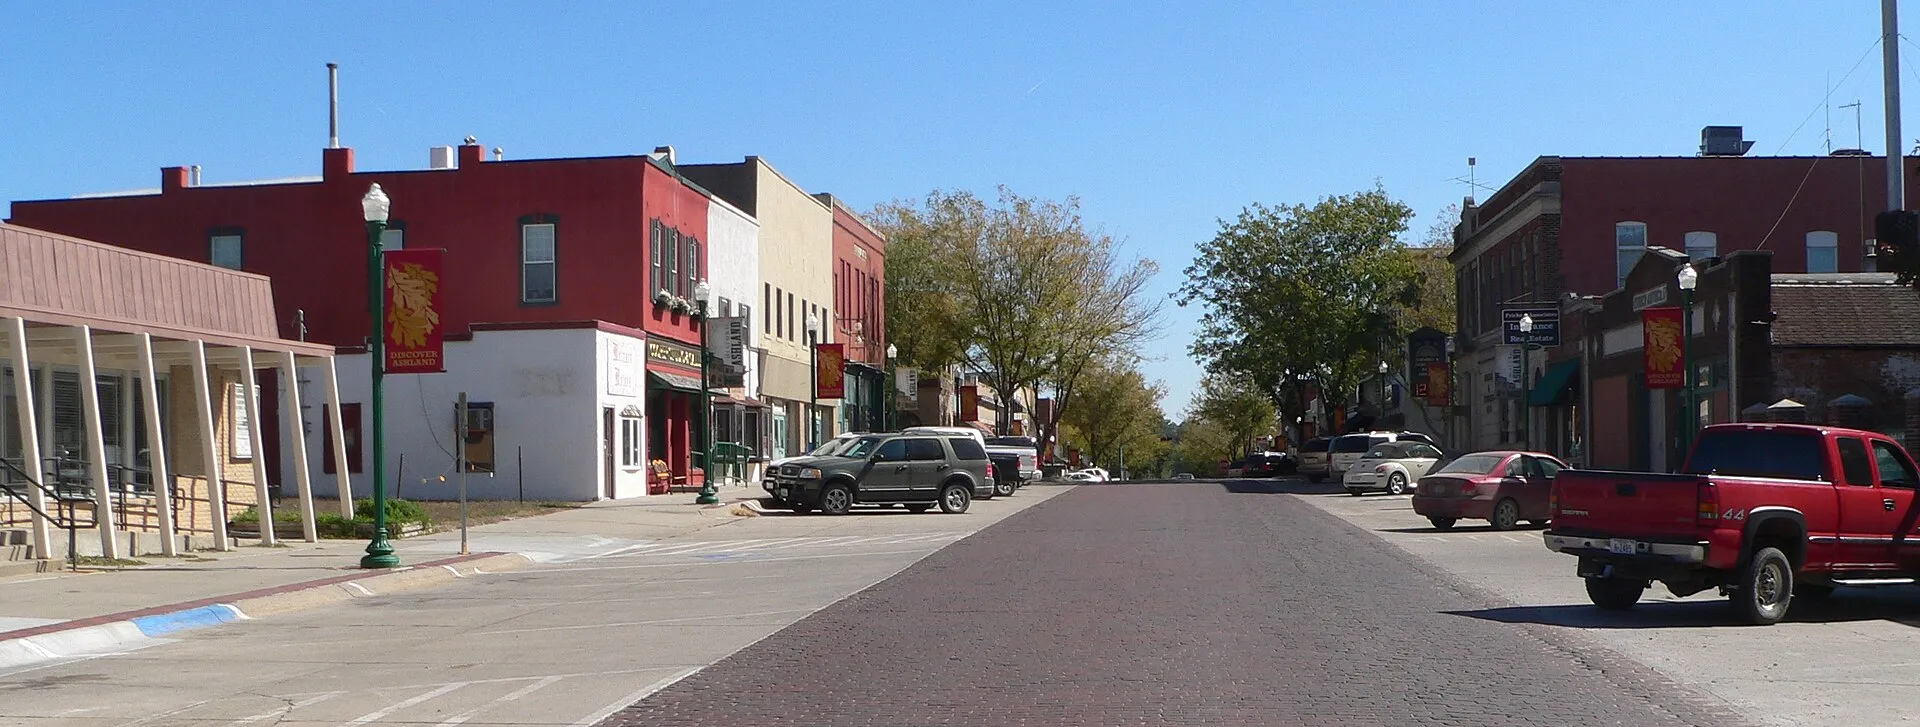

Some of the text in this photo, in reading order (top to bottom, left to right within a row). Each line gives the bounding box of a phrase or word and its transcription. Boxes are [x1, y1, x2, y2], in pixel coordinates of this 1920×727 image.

[1509, 323, 1553, 331] Inance
[730, 321, 742, 365] ASHLAND
[391, 351, 438, 359] DISCOVER
[392, 359, 436, 367] ASHLAND
